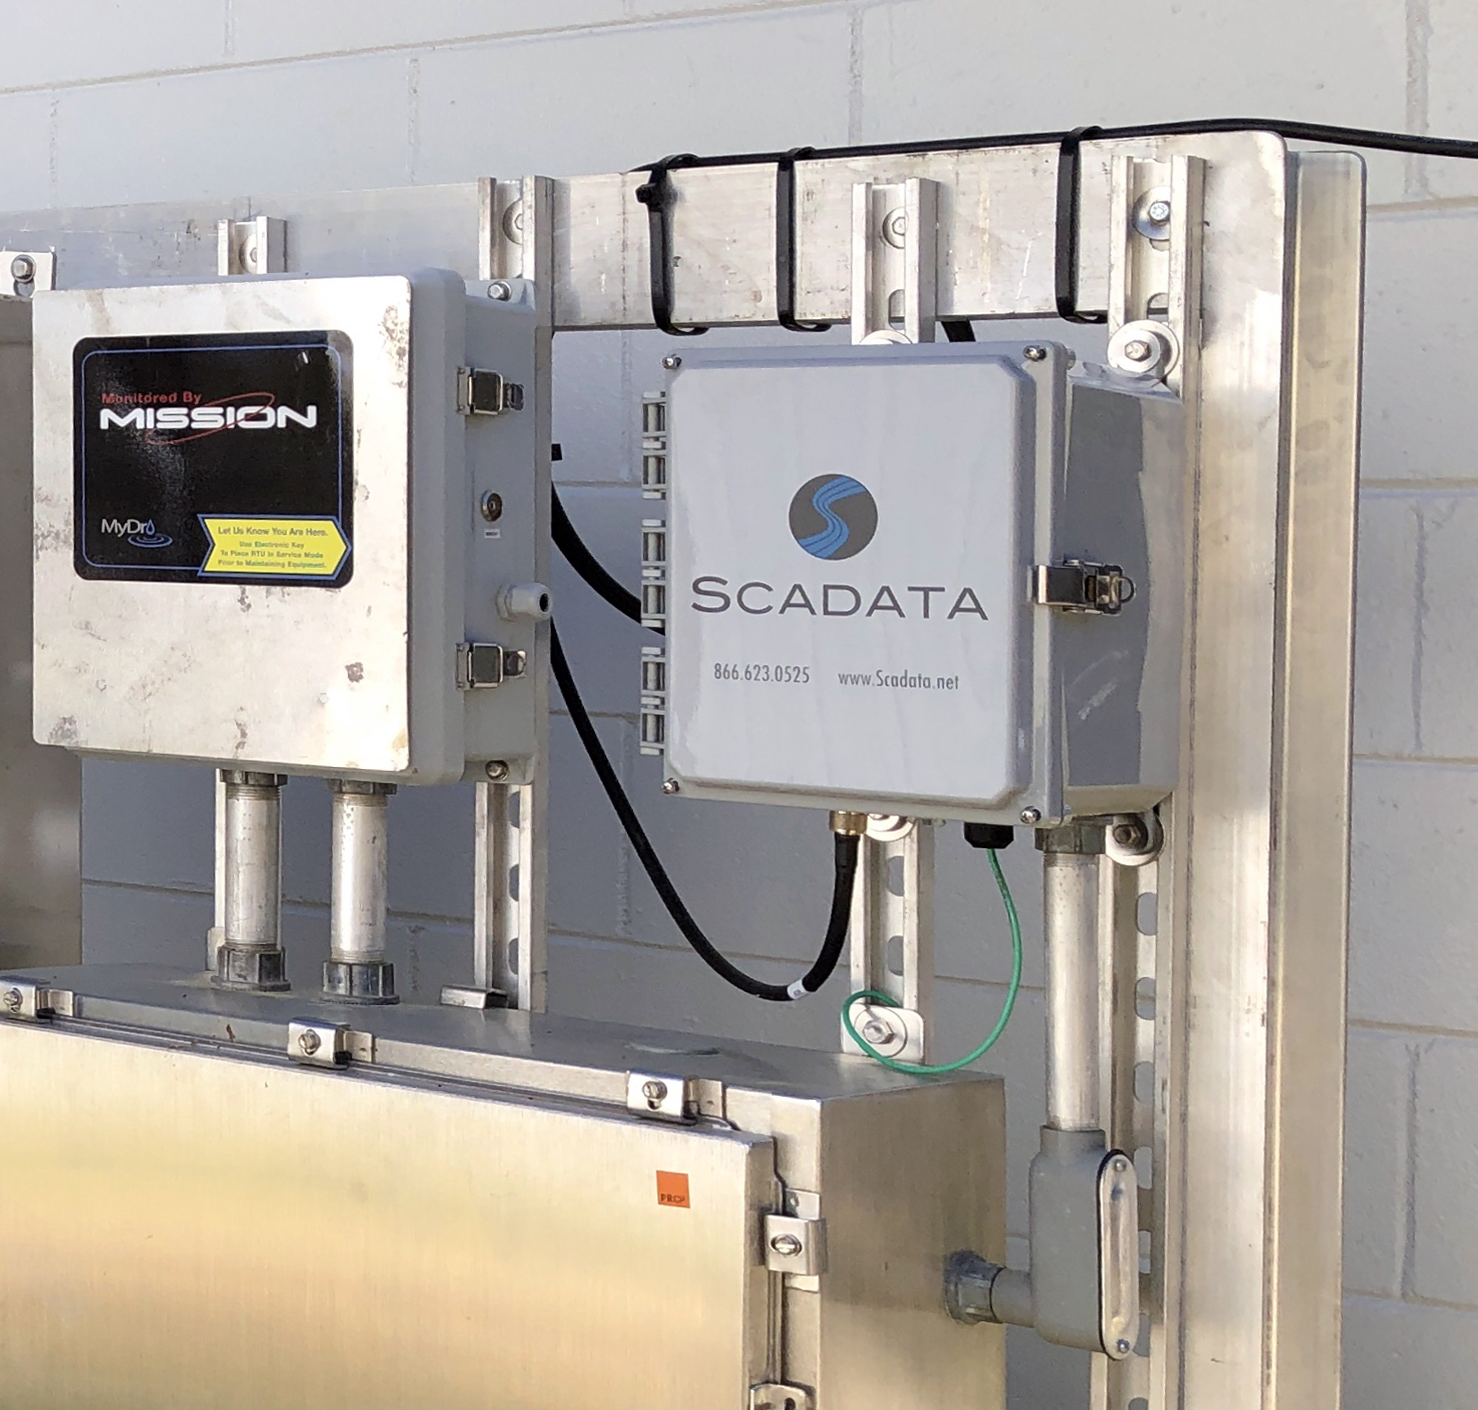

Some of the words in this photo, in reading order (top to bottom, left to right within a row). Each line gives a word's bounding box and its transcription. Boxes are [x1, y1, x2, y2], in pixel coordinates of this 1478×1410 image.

[101, 391, 178, 404] Monitored
[182, 390, 202, 405] By
[100, 405, 318, 430] MISSION
[218, 526, 232, 535] Let
[233, 526, 244, 535] Us
[246, 527, 269, 535] Know
[272, 527, 287, 536] You
[289, 528, 304, 536] Are
[306, 528, 328, 537] Here.
[239, 540, 252, 548] Use
[291, 541, 305, 550] Key
[245, 559, 285, 569] Maintaining
[691, 575, 989, 621] SCADATA
[713, 662, 810, 684] 866.623.0525
[838, 669, 960, 690] www.Scadata.net
